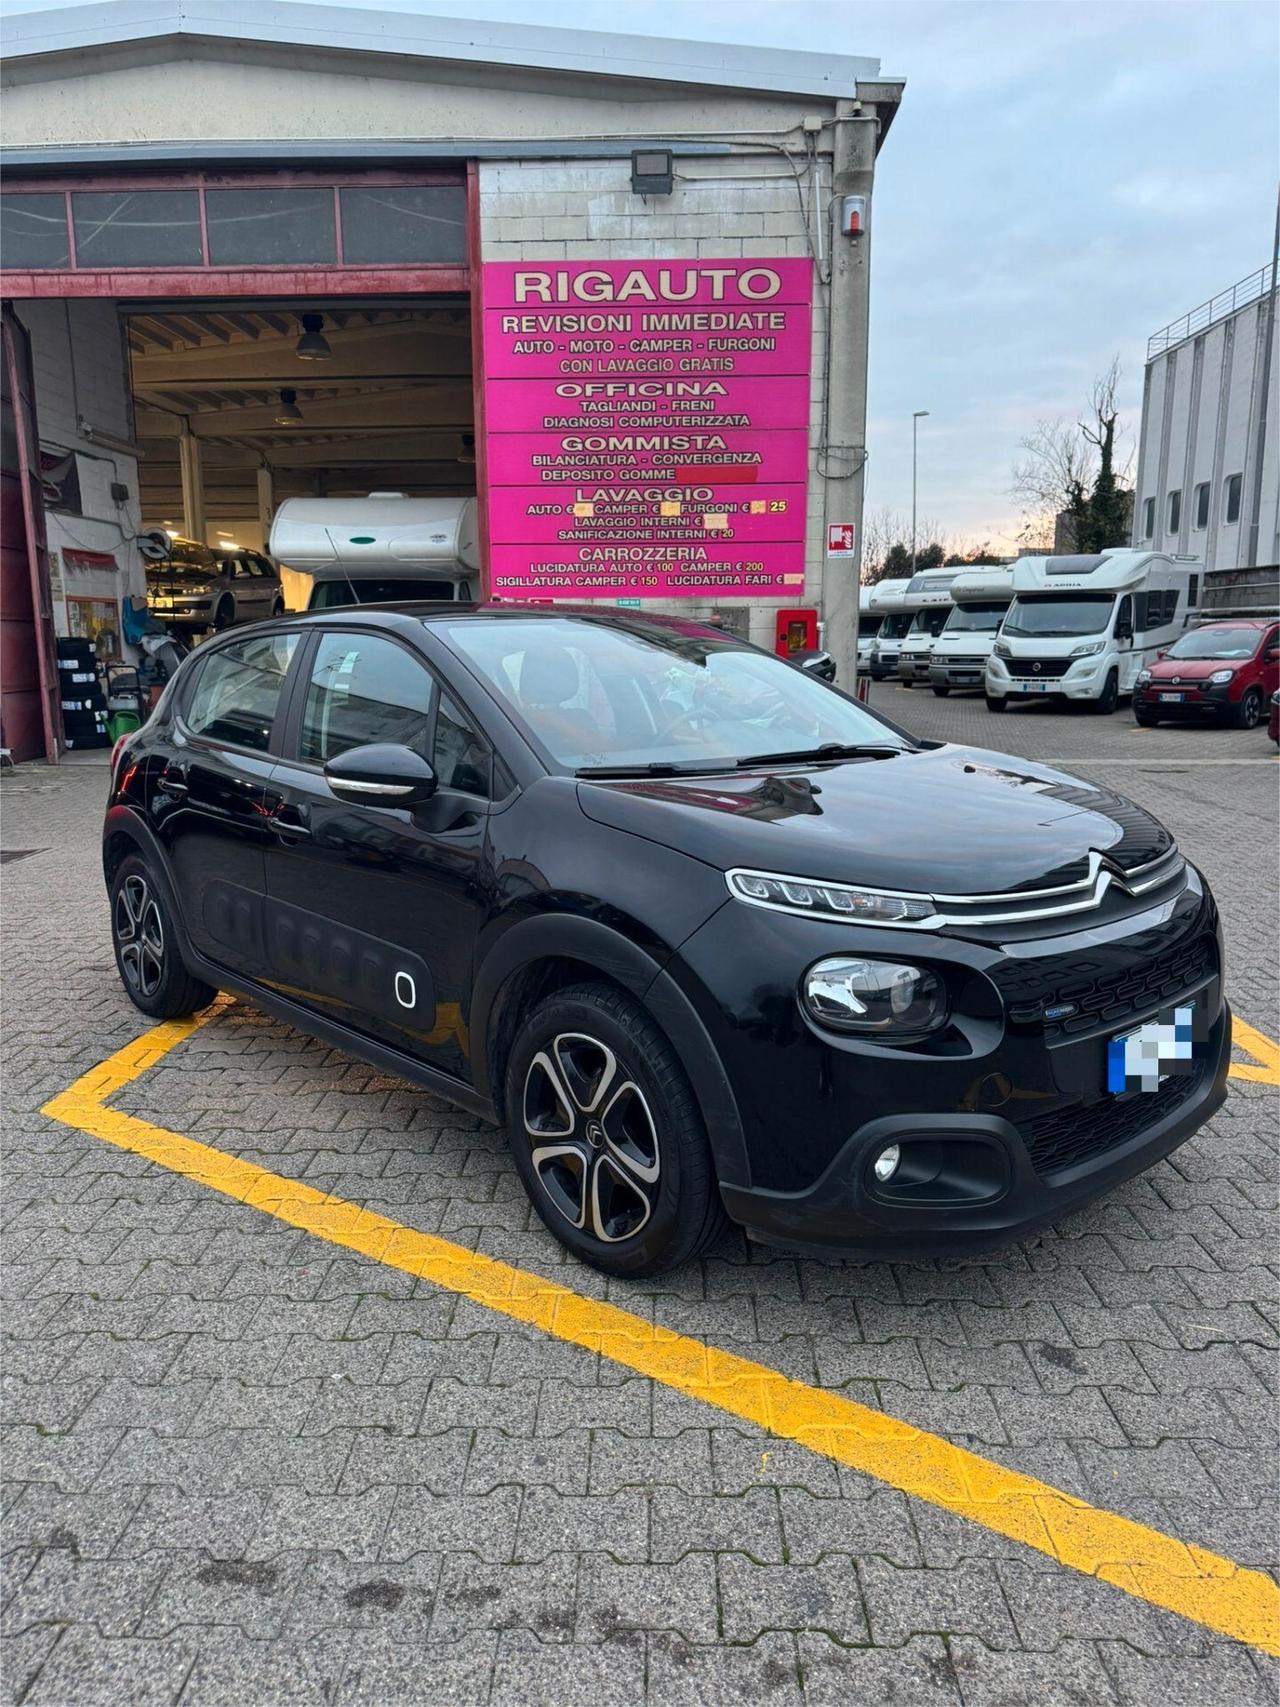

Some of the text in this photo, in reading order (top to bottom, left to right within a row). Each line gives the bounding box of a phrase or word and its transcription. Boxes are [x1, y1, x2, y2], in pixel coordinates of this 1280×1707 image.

[514, 268, 782, 303] RIGAUTO
[502, 313, 786, 334] REVISIONI IMMEDIATE
[514, 340, 553, 354] AUTO
[569, 340, 614, 353] MOTO
[630, 339, 692, 352] CAMPER
[708, 338, 775, 351] FURGONI
[560, 358, 734, 373] CON LAVAGGIO GRATIS
[555, 382, 728, 397] OFFICINA
[580, 401, 656, 412] TAGLIANDI
[672, 401, 714, 411] FRENI
[544, 415, 749, 428] DIAGNOSI COMPUTERIZZATA
[562, 436, 726, 451] GOMMISTA
[533, 454, 636, 466] BILANCIATURA
[652, 453, 762, 465] CONVERGENZA
[542, 468, 676, 481] DEPOSITO GOMME
[576, 488, 714, 502] LAVAGGIO
[527, 501, 787, 515] AUTO € CAMPER € FURGONI € 25
[575, 517, 702, 528] LAVAGGIO INTERNI €
[558, 528, 734, 540] SANIFICAZIONE INTERNI € 20
[579, 548, 707, 562] CARROZZERIA
[530, 562, 763, 573] LUCIDATURA AUTO € 100 CAMPER € 200
[496, 574, 783, 587] SIGILLATURA CAMPER € 150 LUCIDATURA FARI €
